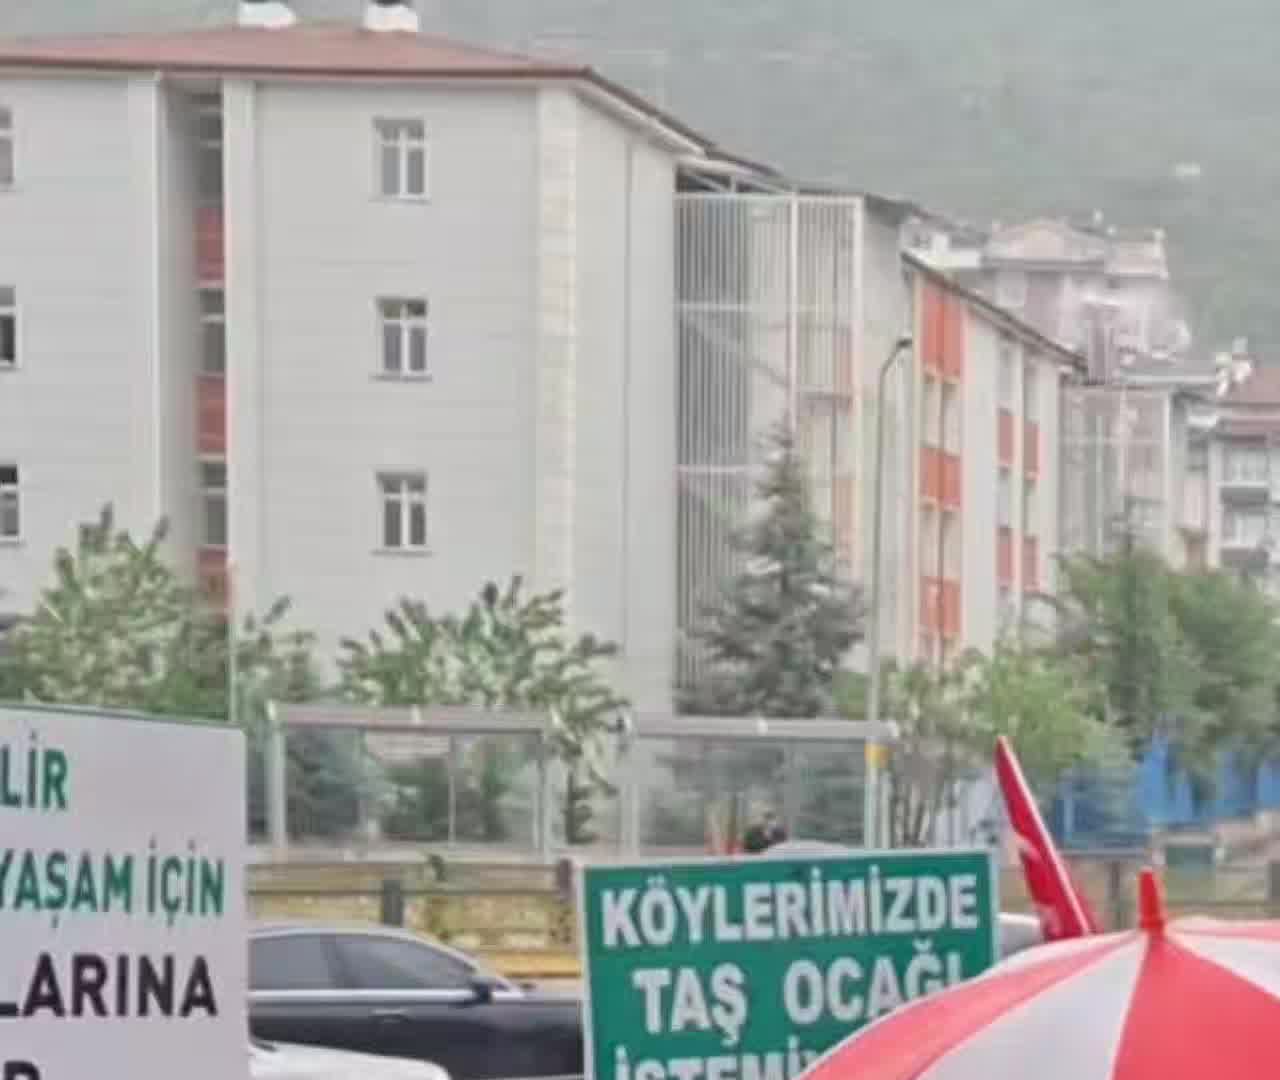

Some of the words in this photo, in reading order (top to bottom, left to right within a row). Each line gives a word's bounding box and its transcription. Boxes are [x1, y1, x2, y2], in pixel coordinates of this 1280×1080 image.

[147, 838, 225, 928] İÇİN
[601, 865, 979, 948] KÖYLERİMİZDE
[632, 962, 748, 1046] TAŞ
[783, 938, 963, 1025] OCAĞI
